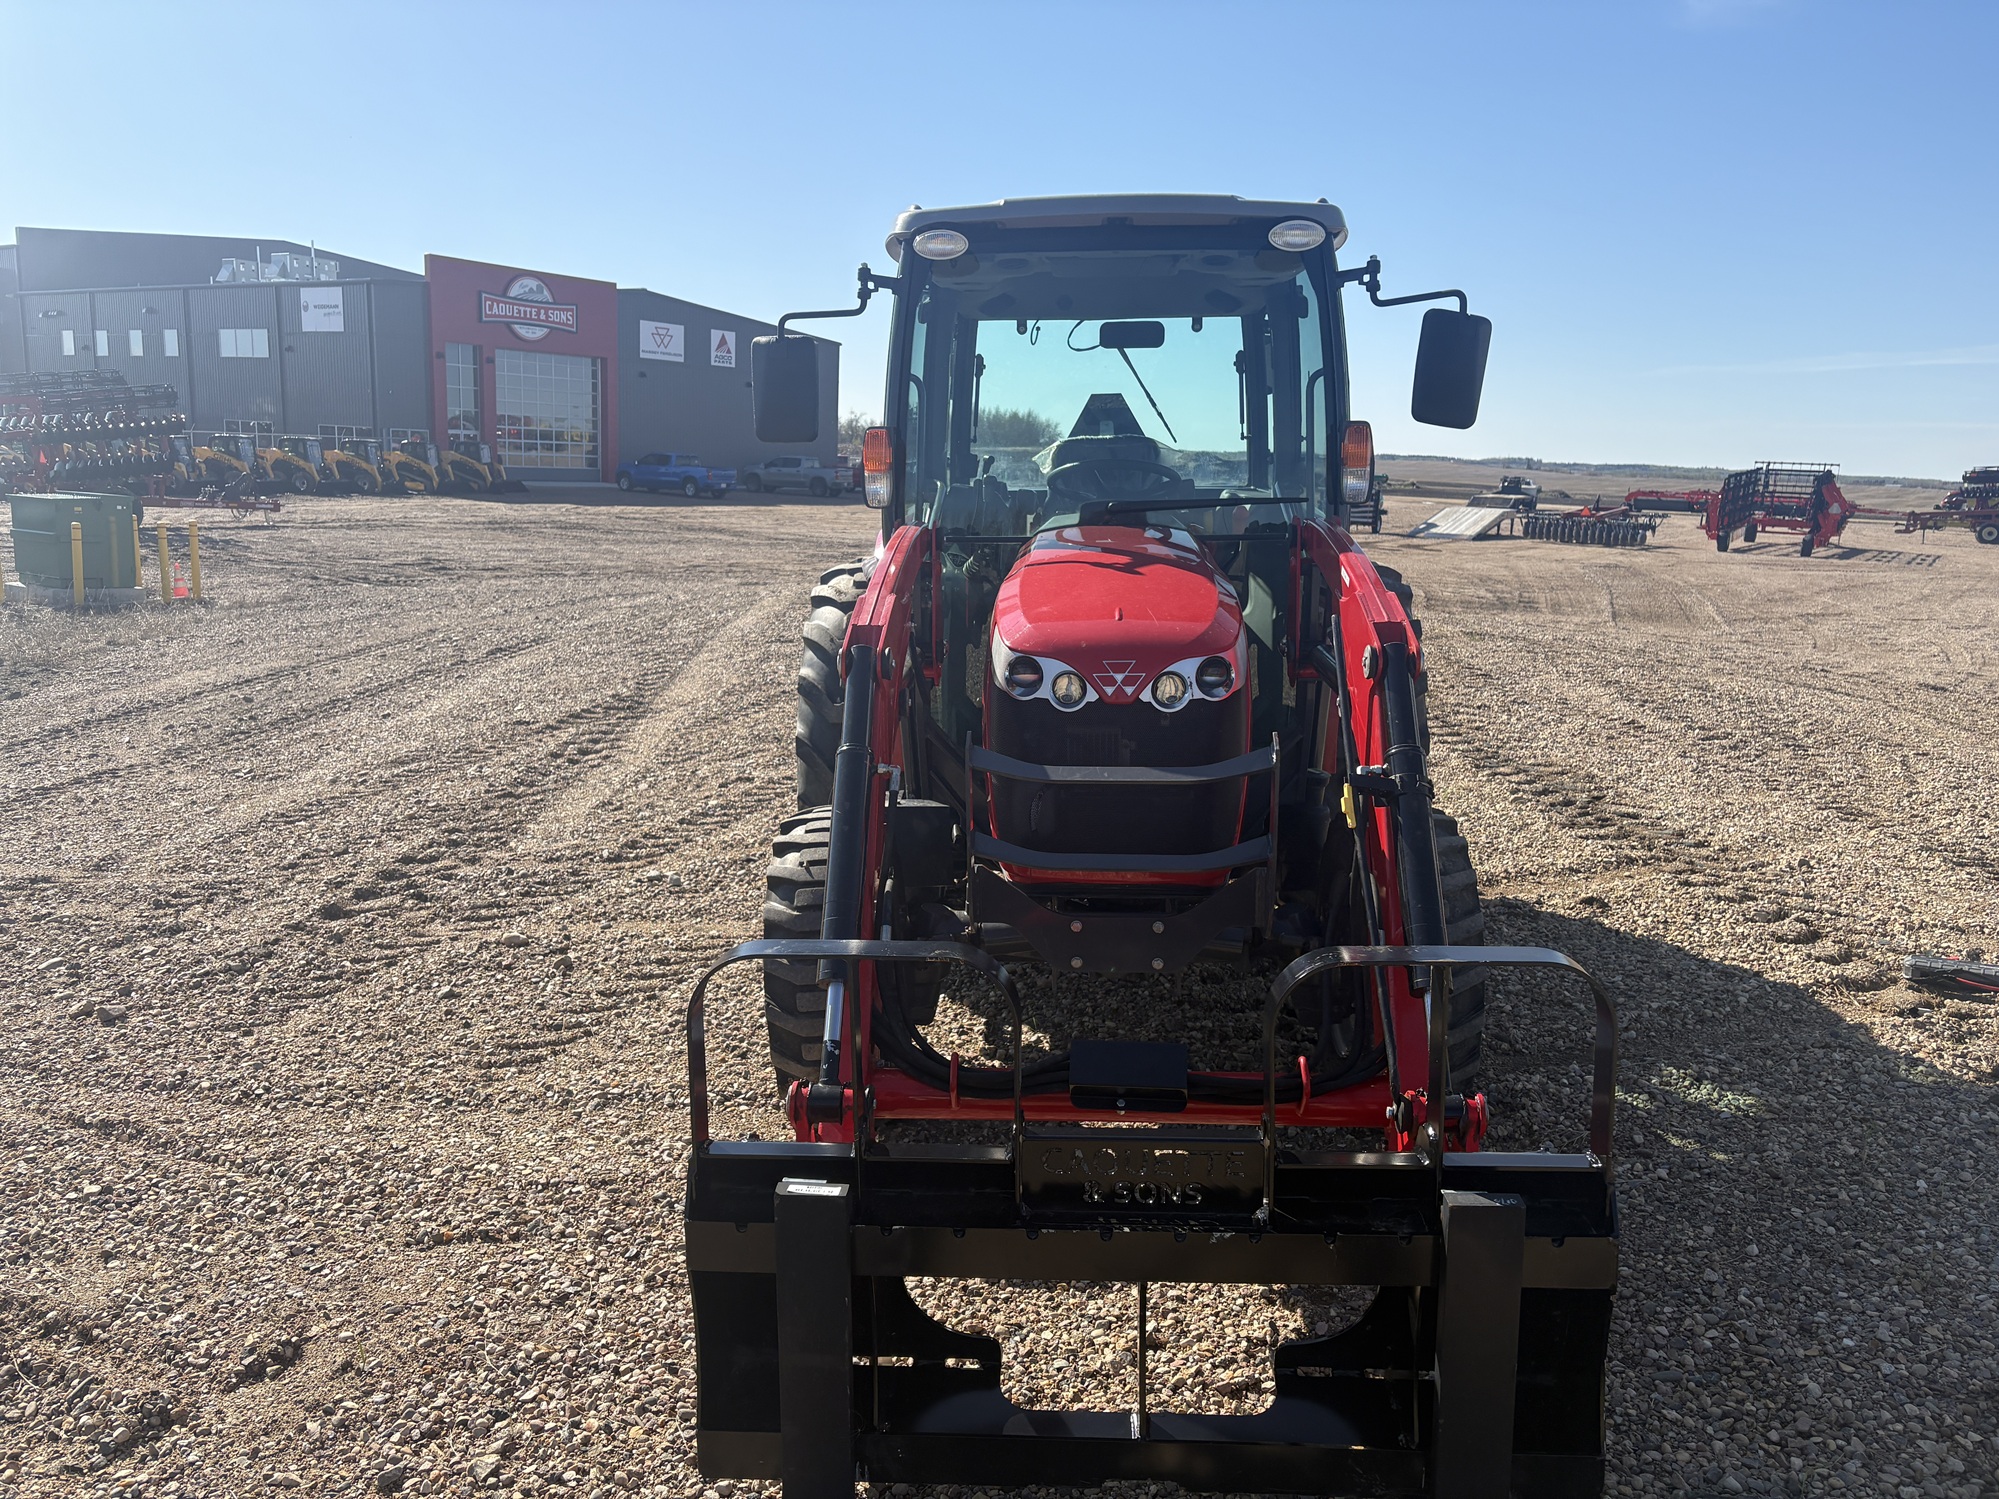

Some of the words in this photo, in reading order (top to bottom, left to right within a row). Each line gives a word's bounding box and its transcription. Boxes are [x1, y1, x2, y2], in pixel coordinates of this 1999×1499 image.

[486, 300, 538, 319] CAOUETTE
[539, 309, 546, 320] &
[547, 310, 573, 325] SONS
[1042, 1148, 1245, 1178] CAOUETTE
[1082, 1180, 1105, 1203] &
[1112, 1180, 1204, 1205] SONS
